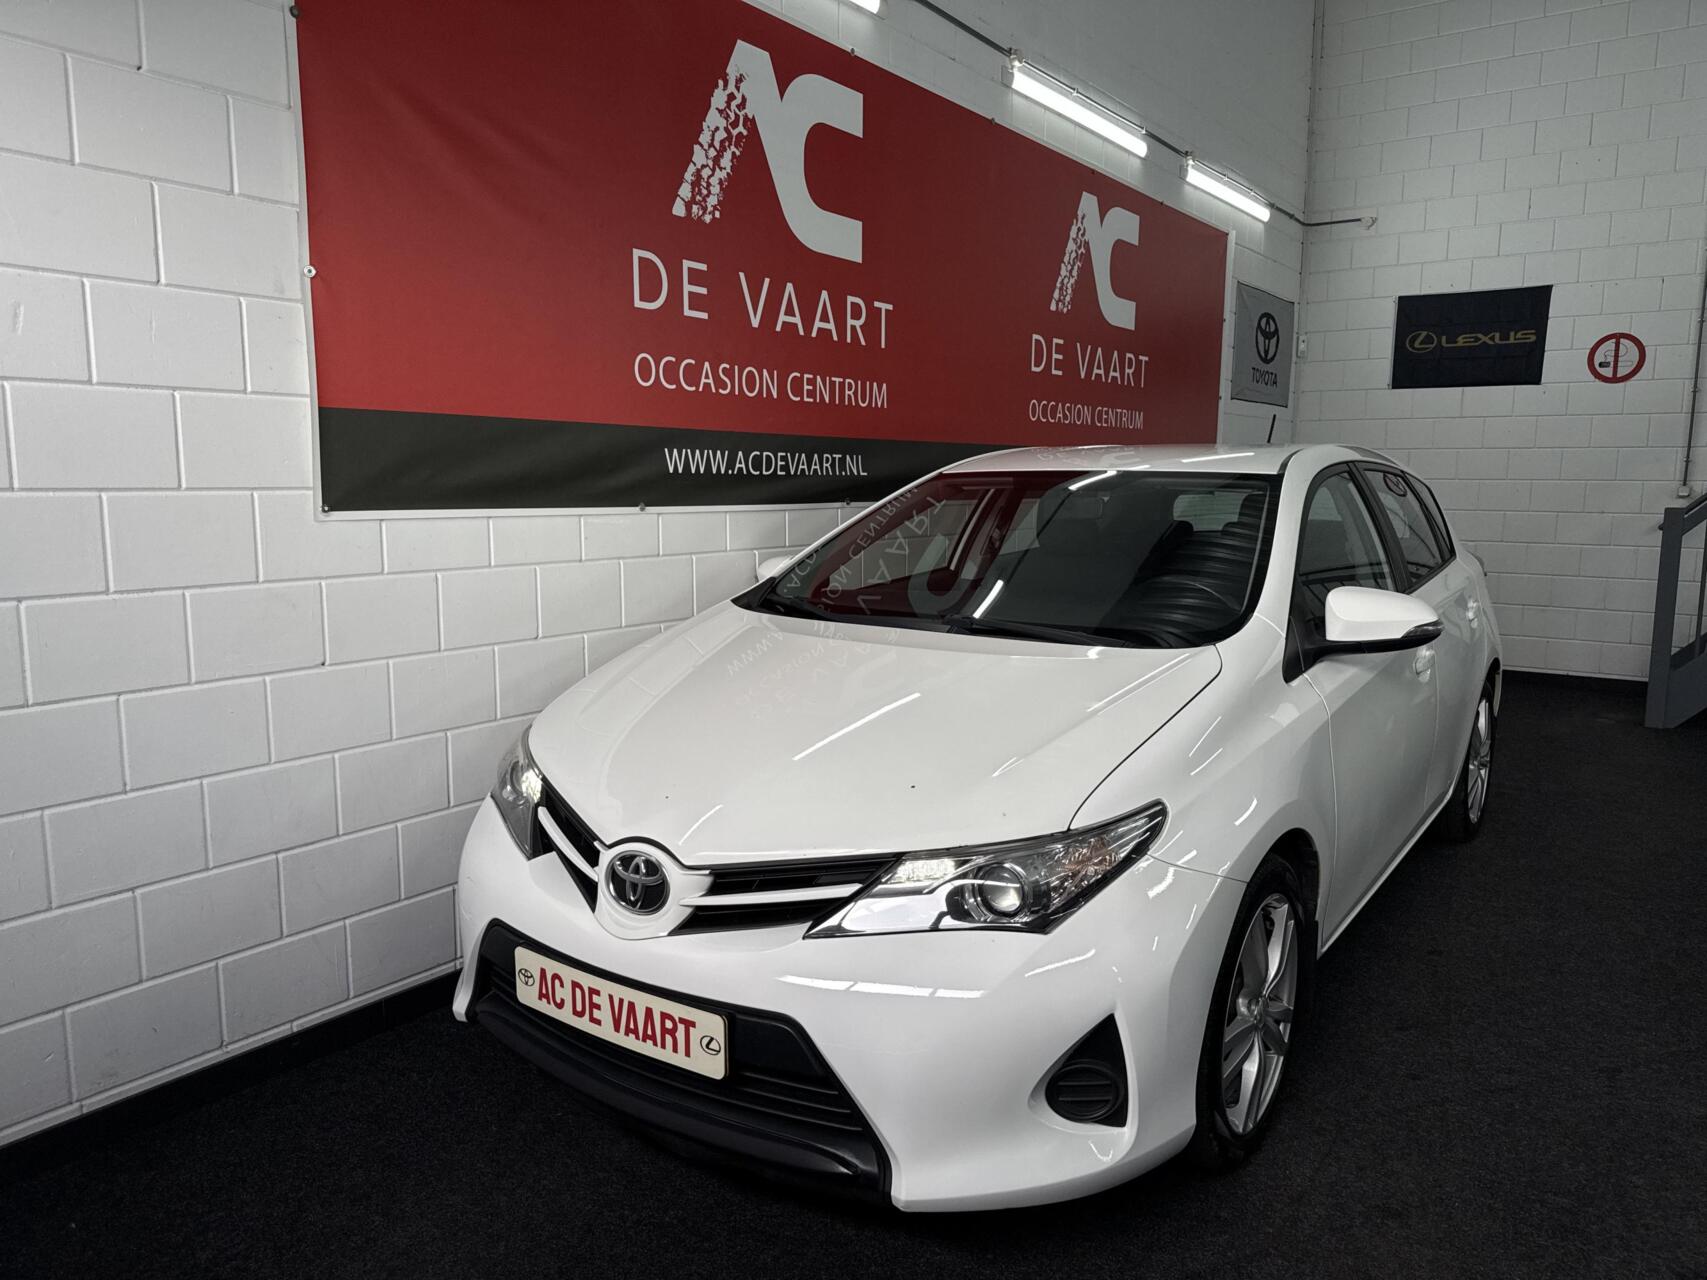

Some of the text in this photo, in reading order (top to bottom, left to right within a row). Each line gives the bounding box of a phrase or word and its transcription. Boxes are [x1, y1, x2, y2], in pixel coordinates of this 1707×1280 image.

[672, 39, 864, 264] AC
[1050, 191, 1140, 331] AC
[632, 247, 894, 349] DE VAART
[1030, 333, 1149, 388] DE VAART
[1441, 330, 1537, 348] LEXUS
[634, 352, 888, 409] OCCASION CENTRUM
[1251, 366, 1278, 389] TOYOTA
[1029, 399, 1144, 430] OCCASION CENTRUM
[664, 447, 868, 477] WWW.ACDEVAART.NL
[537, 967, 697, 1058] AC DE VAART
